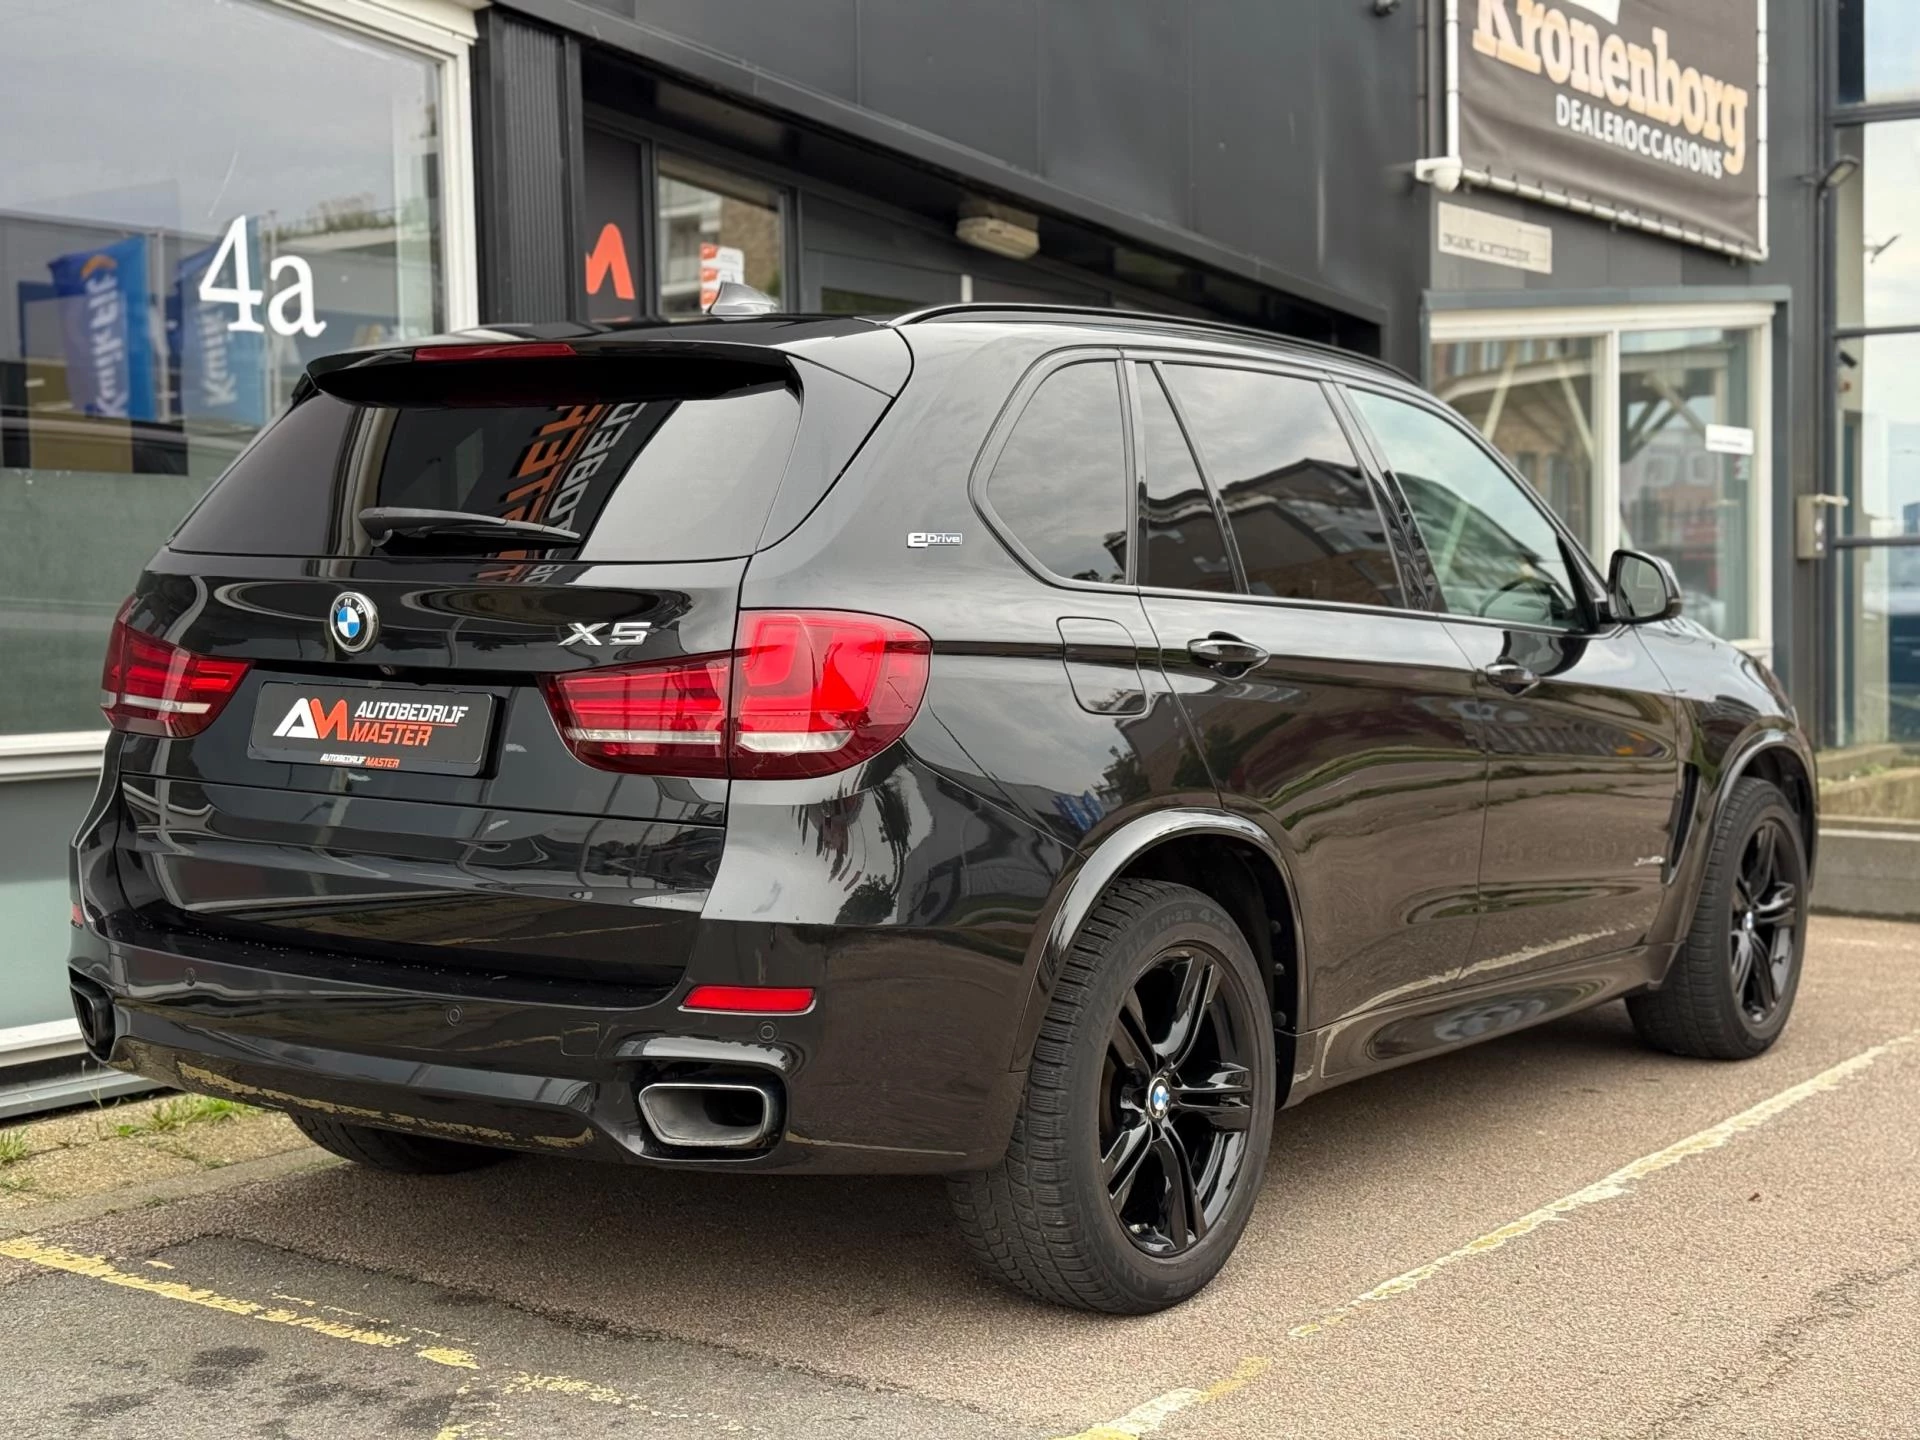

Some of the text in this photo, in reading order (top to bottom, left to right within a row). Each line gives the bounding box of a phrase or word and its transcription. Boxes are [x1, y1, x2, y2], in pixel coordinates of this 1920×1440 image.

[1472, 0, 1748, 175] Kronenborg
[1556, 94, 1723, 180] DEALEROCCASIONS
[199, 214, 327, 338] 4a
[907, 532, 963, 547] eDrive
[334, 598, 365, 615] BMW
[557, 621, 652, 646] X5
[354, 700, 469, 723] AUTOBEDRIJF
[349, 722, 433, 746] MASTER
[320, 753, 400, 768] AUTOBEDRIJF MASTER
